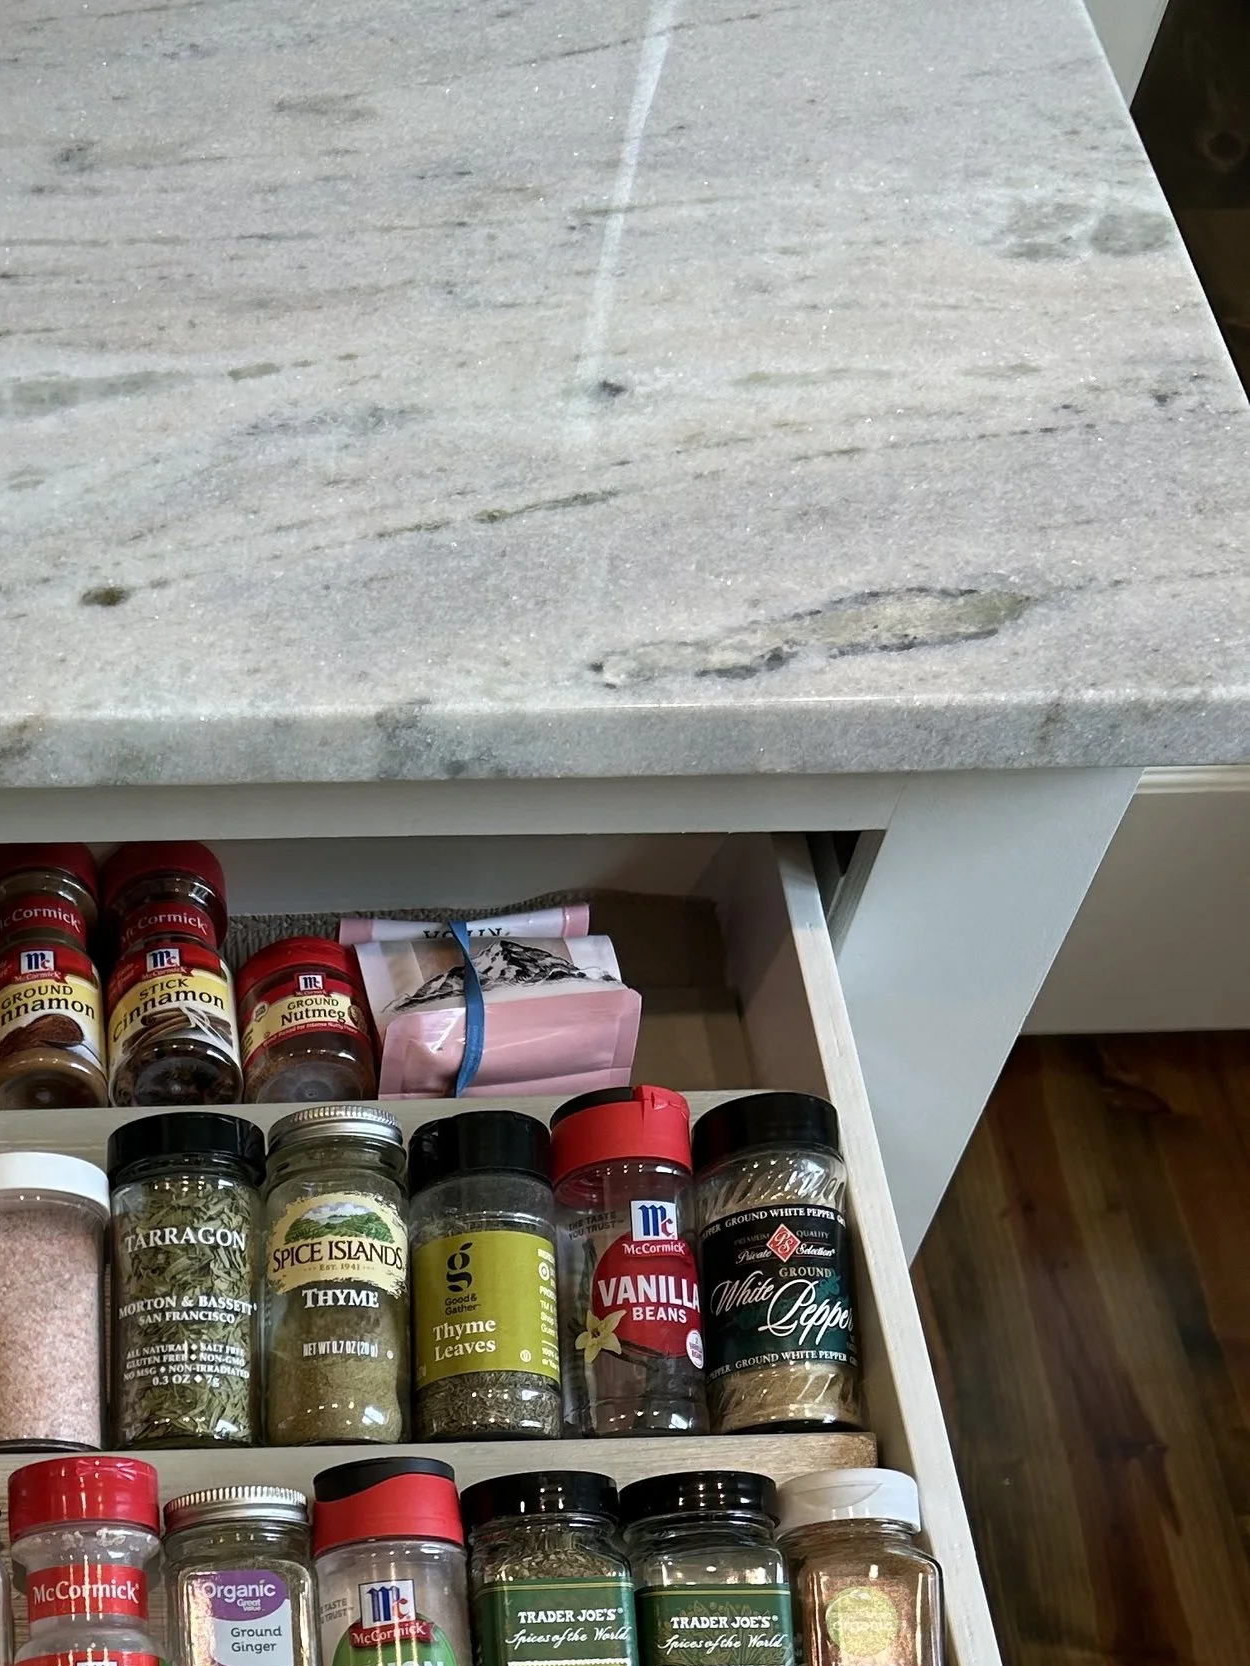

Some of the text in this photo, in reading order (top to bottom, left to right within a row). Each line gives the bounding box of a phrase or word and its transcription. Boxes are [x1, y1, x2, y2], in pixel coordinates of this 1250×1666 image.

[0, 985, 73, 1011] GROUND
[139, 979, 190, 1000] STICK
[287, 998, 339, 1011] GROUND
[113, 990, 224, 1042] Cinnamon
[281, 1008, 346, 1028] Nutmeg
[568, 1211, 616, 1232] THE TASTE
[725, 1207, 835, 1228] GROUND WHITE PEPPER
[124, 1226, 247, 1254] TARRAGON
[568, 1220, 616, 1241] YOU TRUST
[273, 1239, 404, 1273] SPICE ISLANDS
[621, 1241, 686, 1257] McCormick
[779, 1267, 832, 1278] GROUND
[301, 1288, 380, 1309] THYME
[598, 1274, 701, 1315] VANILLA
[710, 1270, 776, 1317] White
[119, 1295, 254, 1320] MORTON & BASSETT
[445, 1303, 479, 1316] Gather
[632, 1306, 688, 1325] BEANS
[138, 1311, 236, 1326] SAN FRANCISCO
[432, 1319, 496, 1347] Thyme
[434, 1339, 497, 1362] Leaves
[735, 1350, 848, 1370] GROUND WHITE PEPPER
[33, 1580, 139, 1605] McCormick
[202, 1580, 277, 1603] Organic
[324, 1598, 347, 1612] TASTE
[518, 1607, 616, 1624] TRADER JOE'S
[231, 1626, 283, 1639] Ground
[670, 1615, 772, 1629] TRADER JOE'S
[352, 1623, 427, 1646] McCormick
[505, 1626, 633, 1650] Spices of the World
[657, 1633, 789, 1655] Spices of the World
[232, 1641, 277, 1656] Ginger
